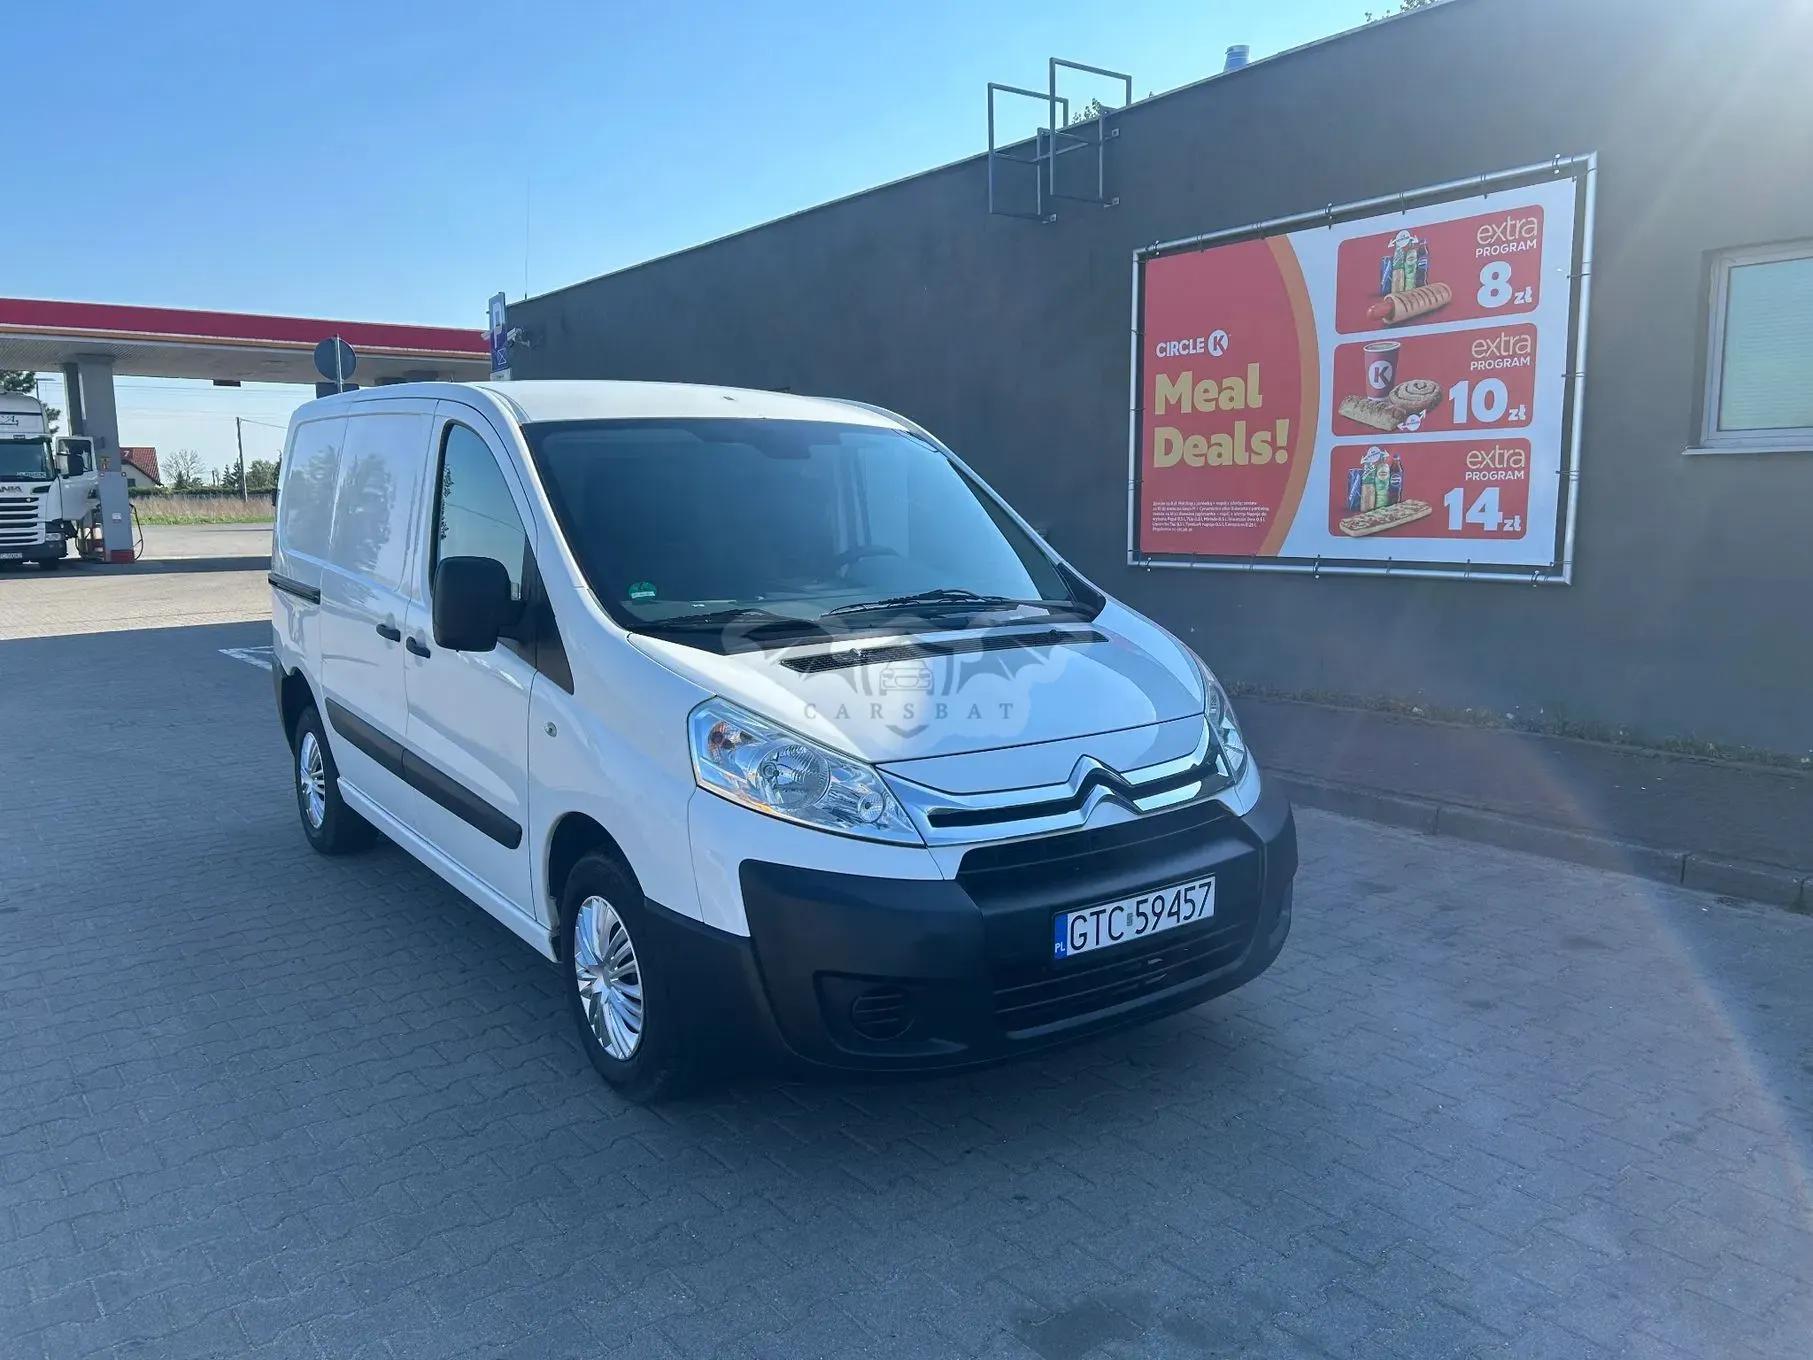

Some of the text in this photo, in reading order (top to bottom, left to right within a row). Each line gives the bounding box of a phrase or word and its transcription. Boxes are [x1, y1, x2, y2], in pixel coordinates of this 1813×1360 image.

[1477, 216, 1537, 244] extra
[1475, 239, 1537, 258] PROGRAM
[1477, 261, 1532, 308] 8 zł
[1156, 332, 1228, 358] CIRCLE K
[1471, 332, 1531, 358] extra
[1373, 364, 1392, 388] K
[1470, 356, 1531, 371] PROGRAM
[1155, 362, 1263, 415] Meal
[1449, 377, 1526, 423] 10 zł
[1154, 419, 1289, 468] Deals!
[1466, 445, 1526, 469] extra
[1465, 470, 1525, 481] PROGRAM
[1444, 487, 1521, 531] 14 zł
[1070, 881, 1212, 951] GTC 59457
[1055, 942, 1066, 953] PL
